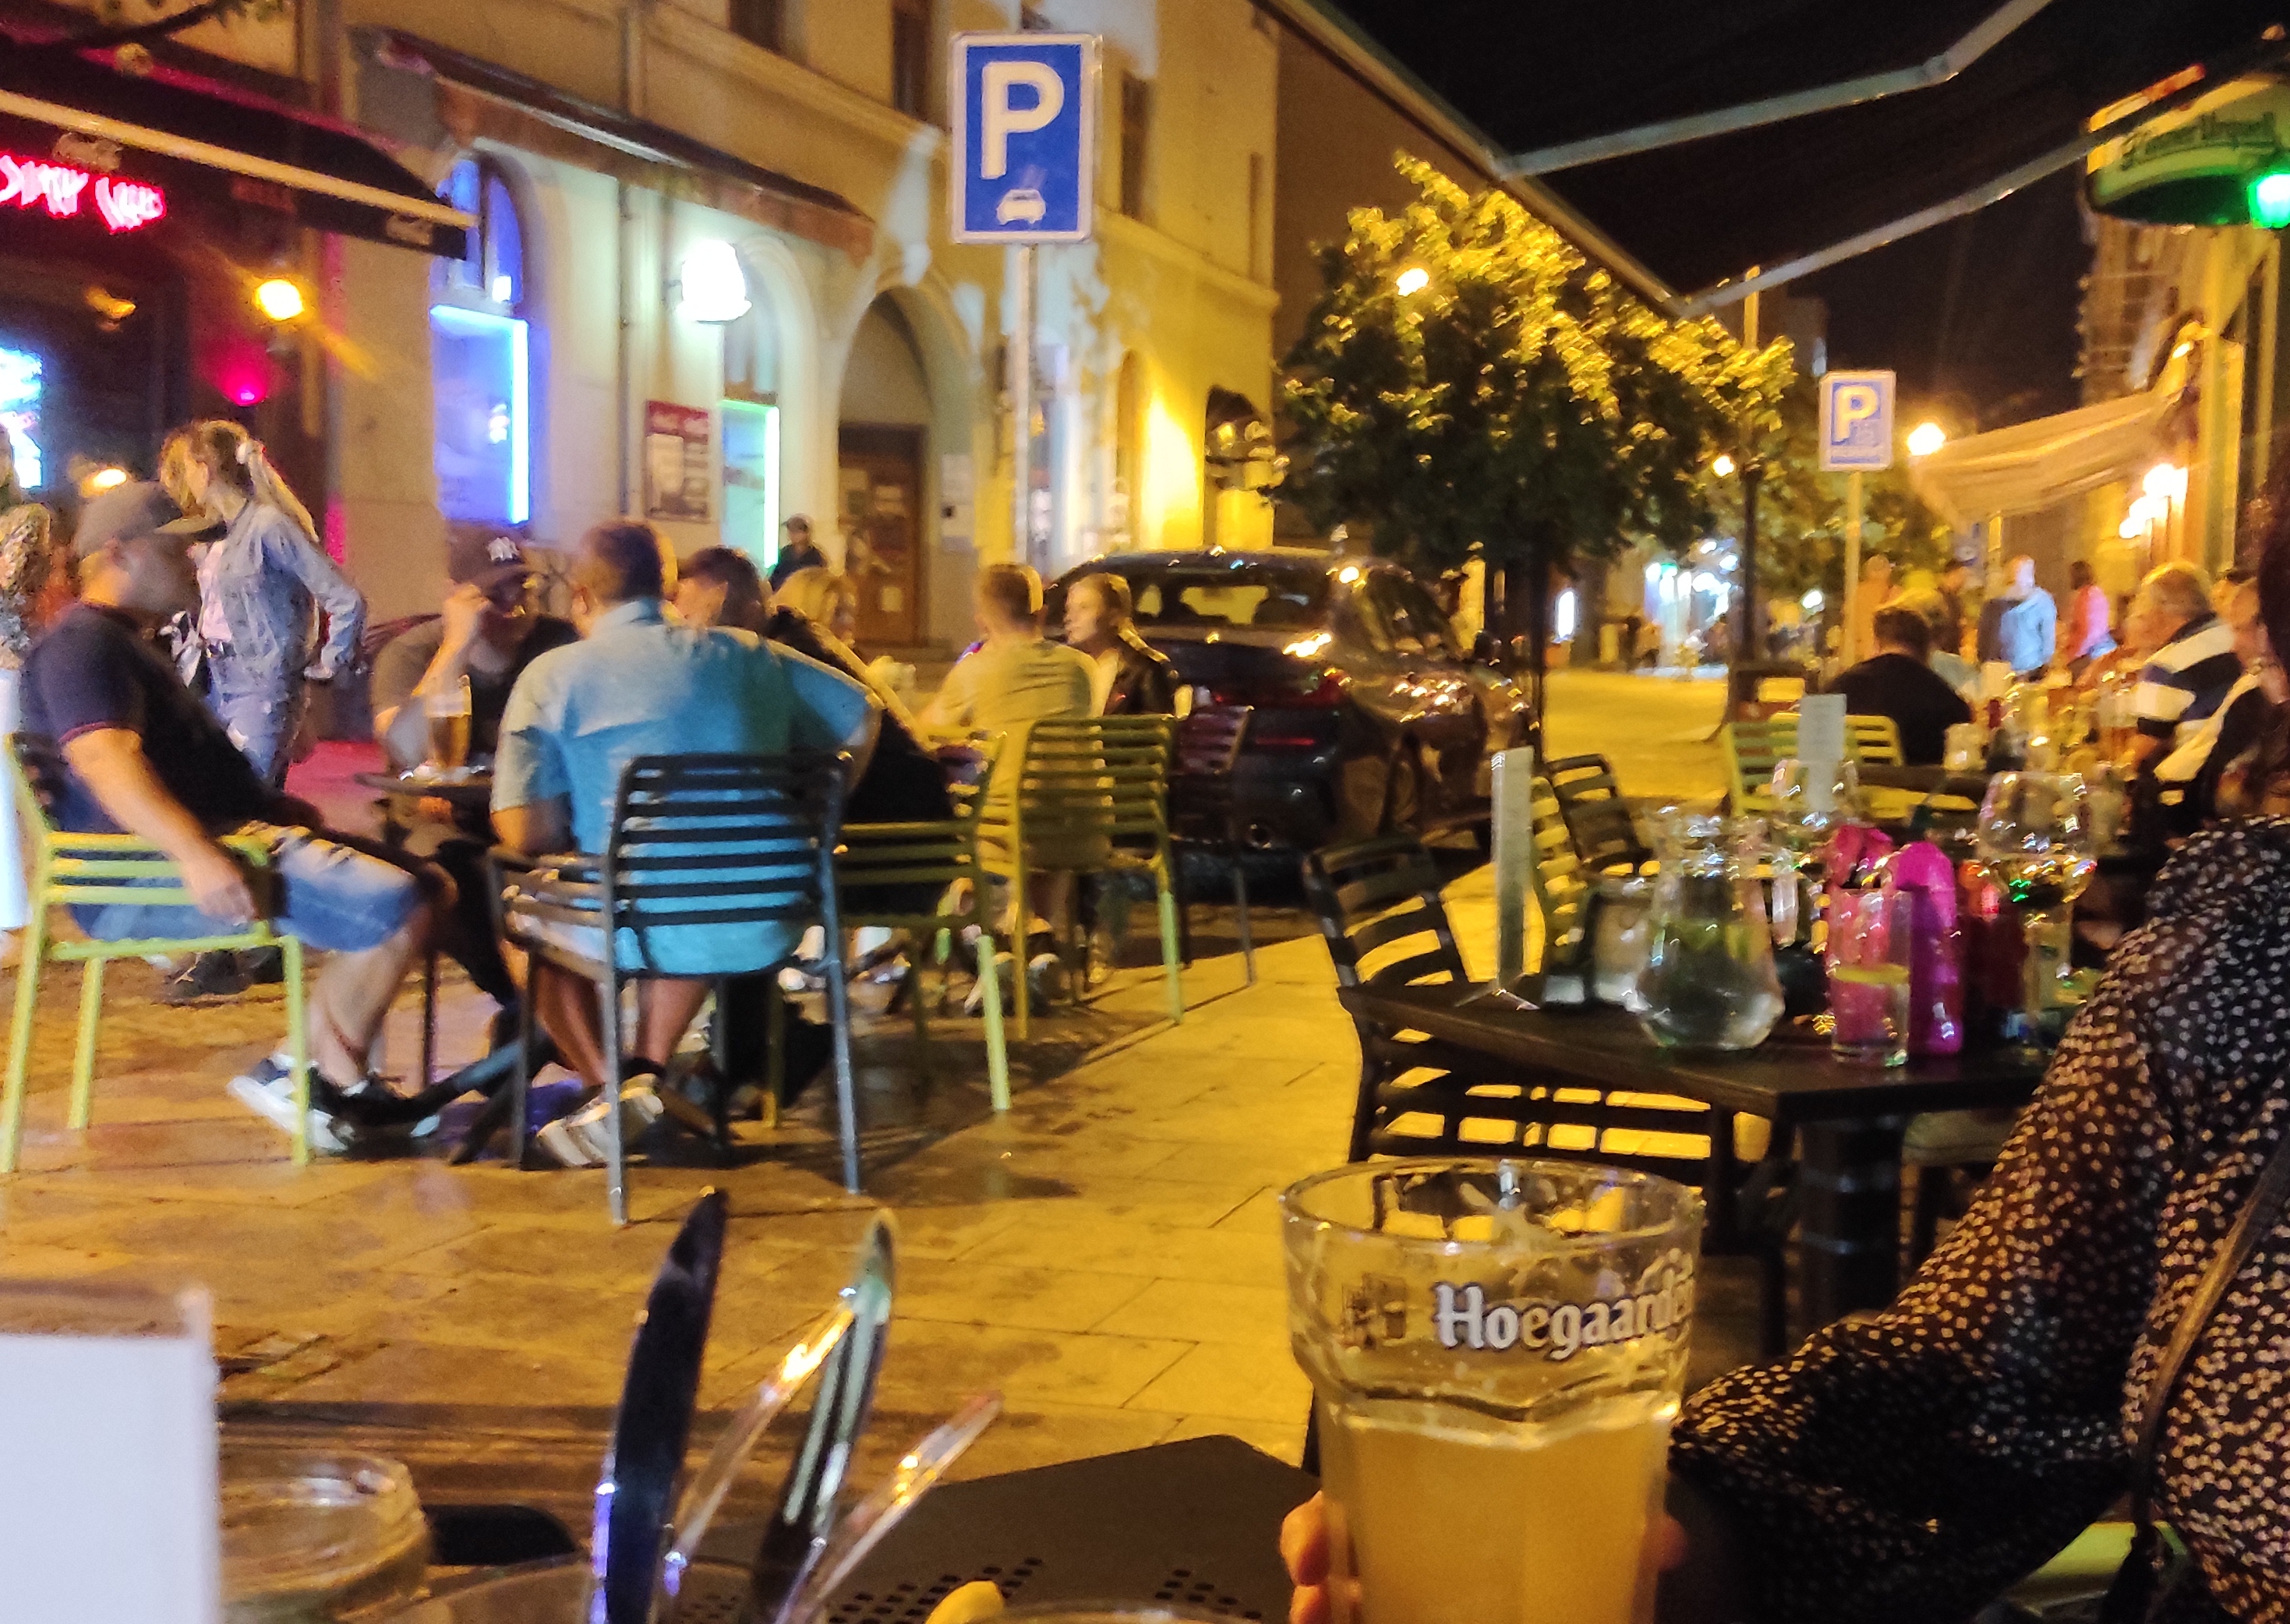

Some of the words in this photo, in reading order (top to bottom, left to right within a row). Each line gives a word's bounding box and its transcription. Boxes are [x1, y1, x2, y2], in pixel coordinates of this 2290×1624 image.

[981, 61, 1065, 179] P
[1835, 386, 1878, 442] P
[1436, 1248, 1694, 1361] Hoegaard
